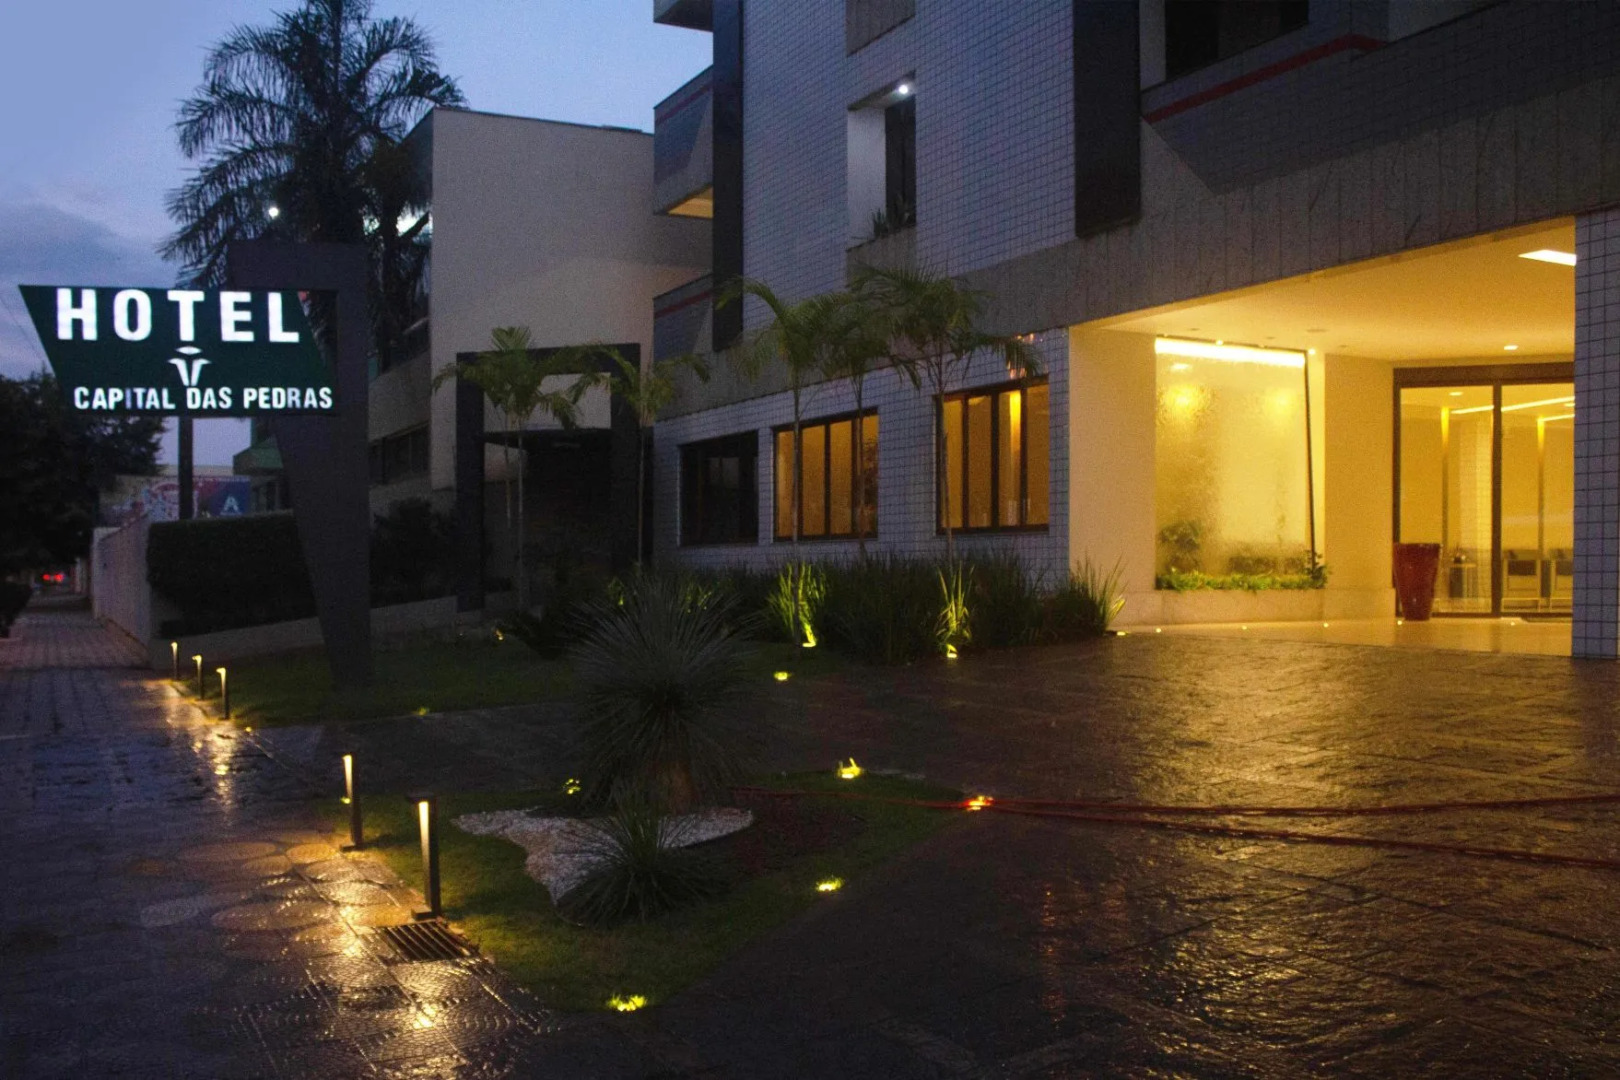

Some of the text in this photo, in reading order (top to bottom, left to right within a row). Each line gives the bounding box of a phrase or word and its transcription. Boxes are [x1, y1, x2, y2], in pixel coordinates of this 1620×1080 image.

[56, 287, 300, 343] HOTEL
[73, 386, 333, 410] CAPITAL DAS PEDRAS
